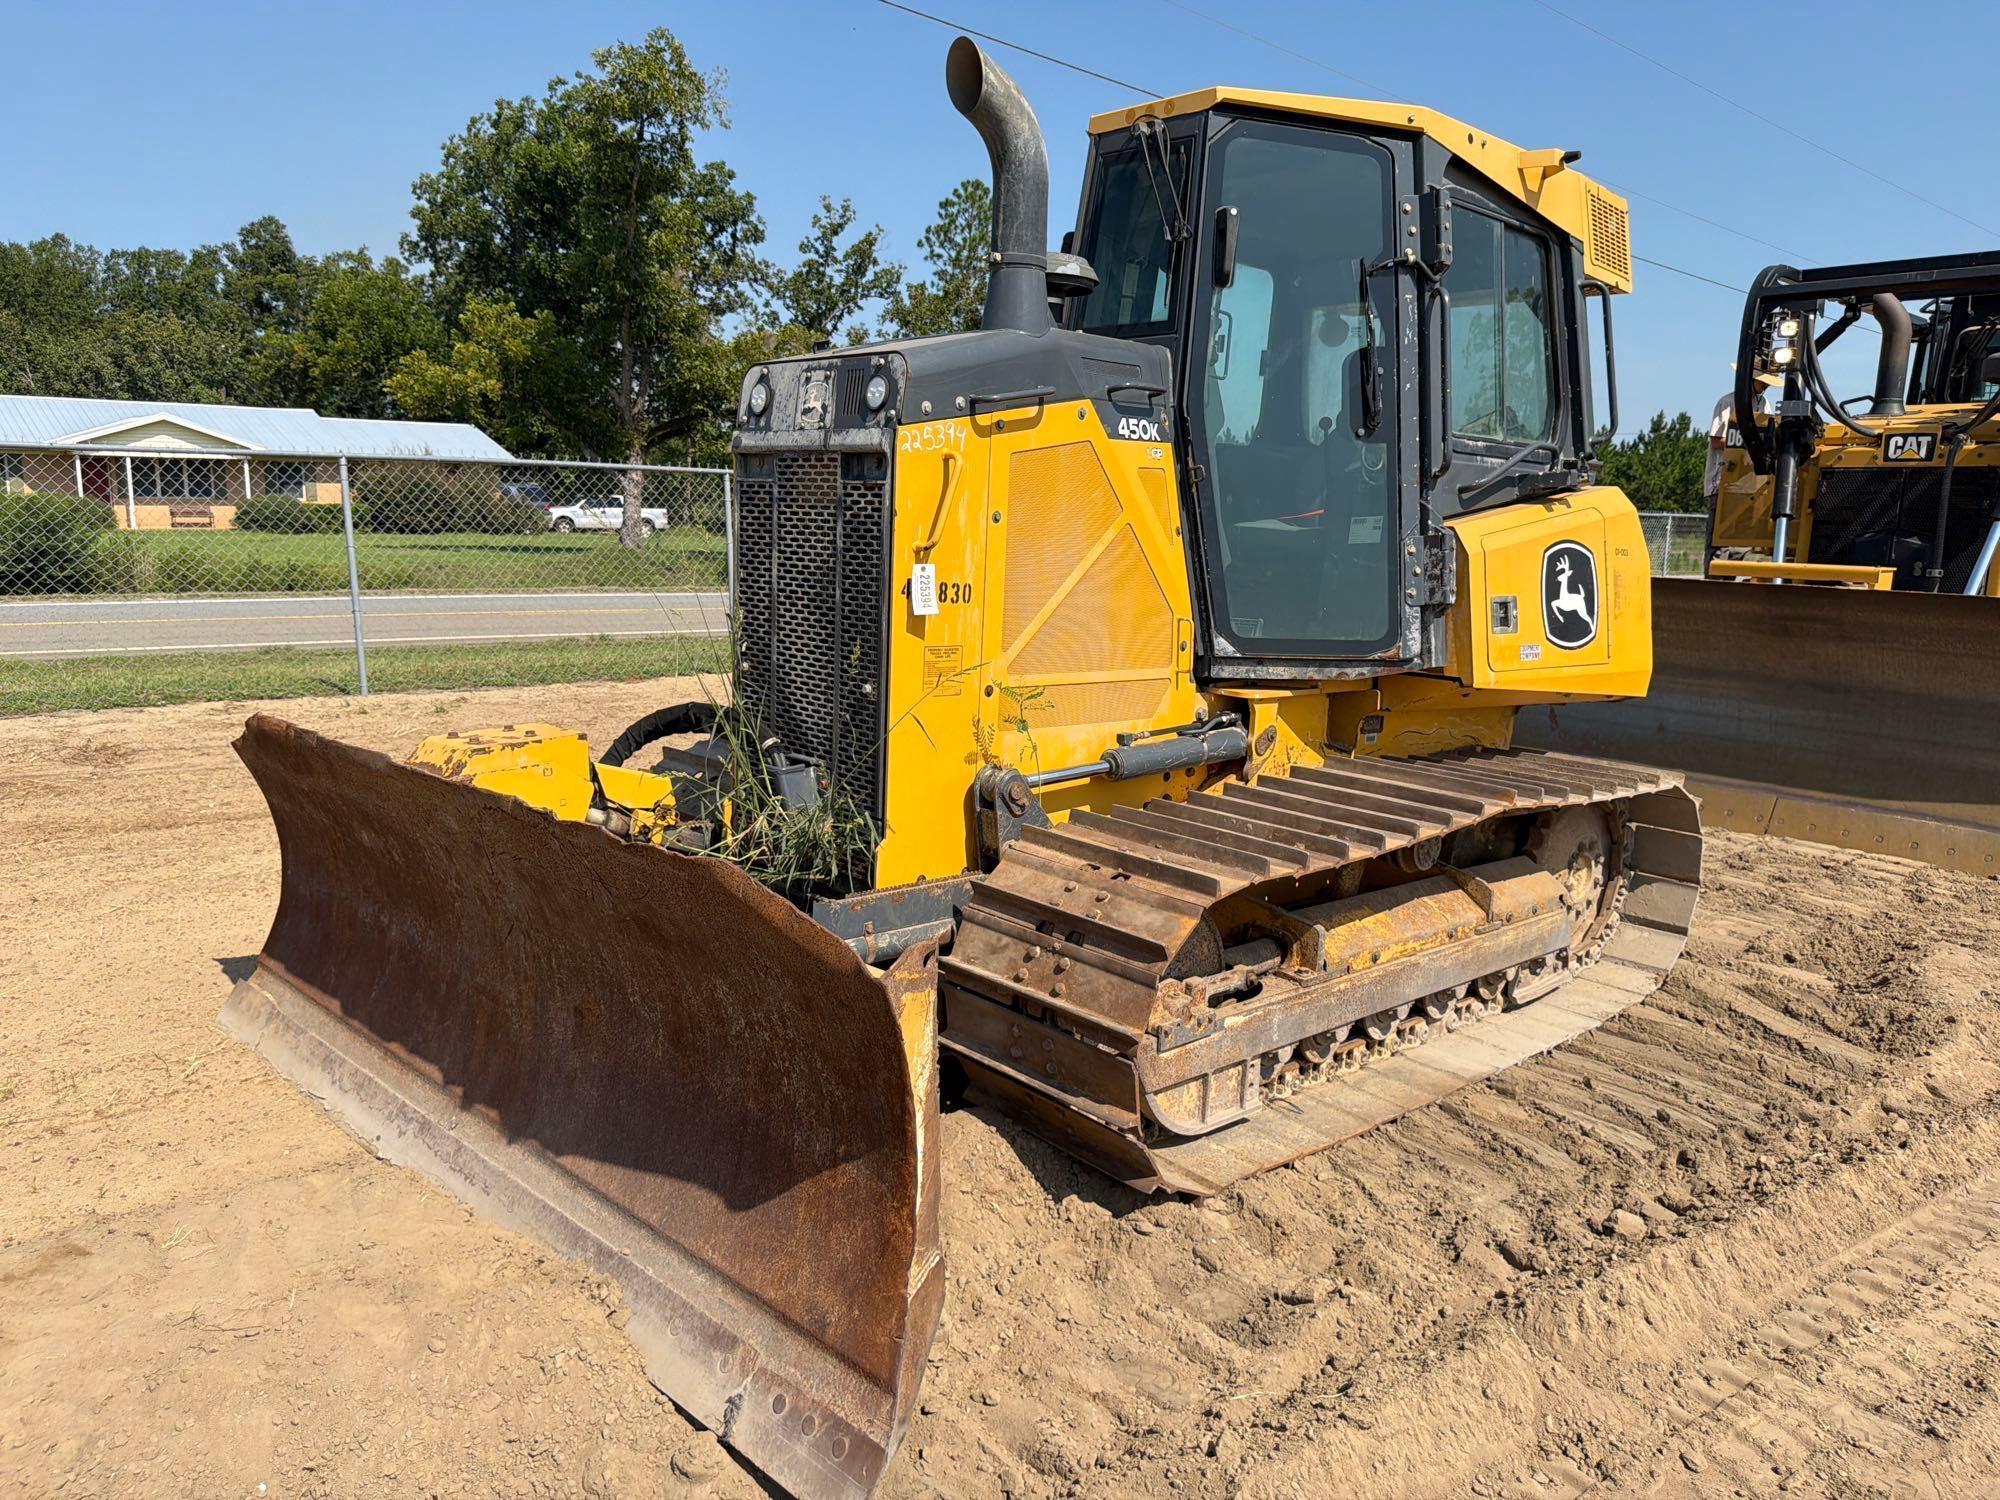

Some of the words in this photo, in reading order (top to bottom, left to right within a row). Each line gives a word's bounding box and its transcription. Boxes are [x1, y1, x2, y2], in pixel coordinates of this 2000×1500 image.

[900, 422, 967, 453] 225394
[1118, 417, 1160, 441] 450K
[1888, 436, 1932, 459] CAT
[919, 574, 932, 609] 225394
